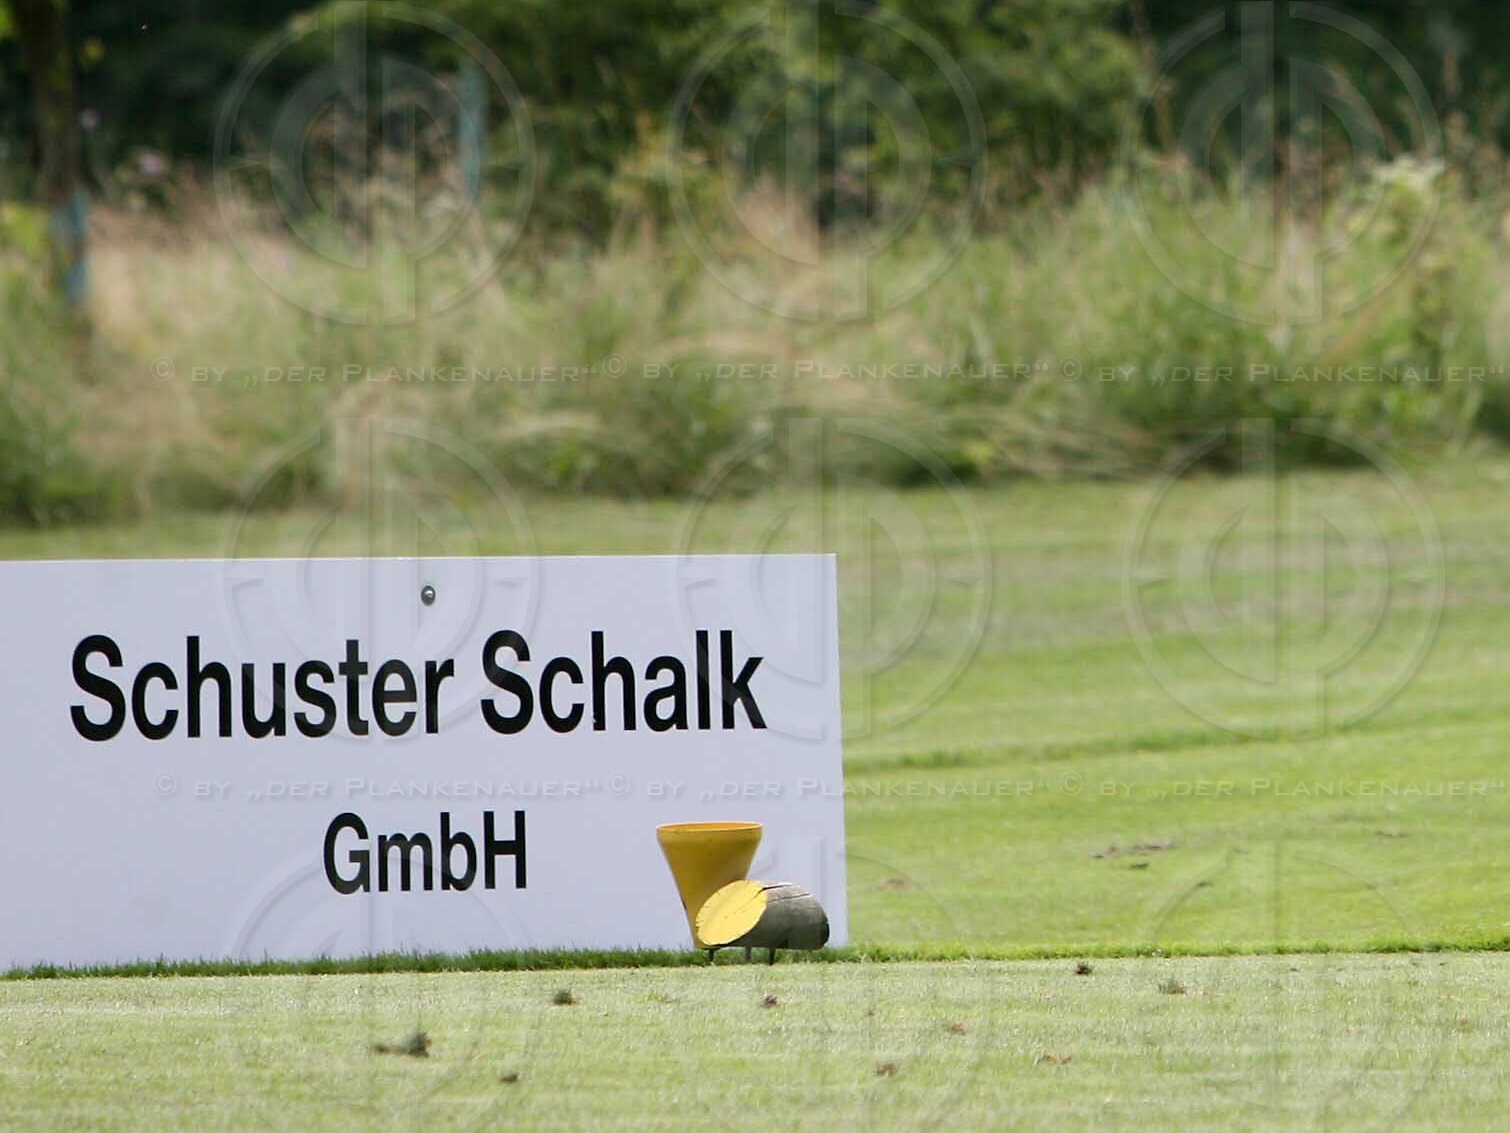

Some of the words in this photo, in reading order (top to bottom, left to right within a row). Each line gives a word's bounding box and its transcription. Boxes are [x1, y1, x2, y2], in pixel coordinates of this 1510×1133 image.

[70, 634, 455, 741] Schuster
[480, 629, 767, 734] Schalk
[323, 810, 527, 894] GmbH
